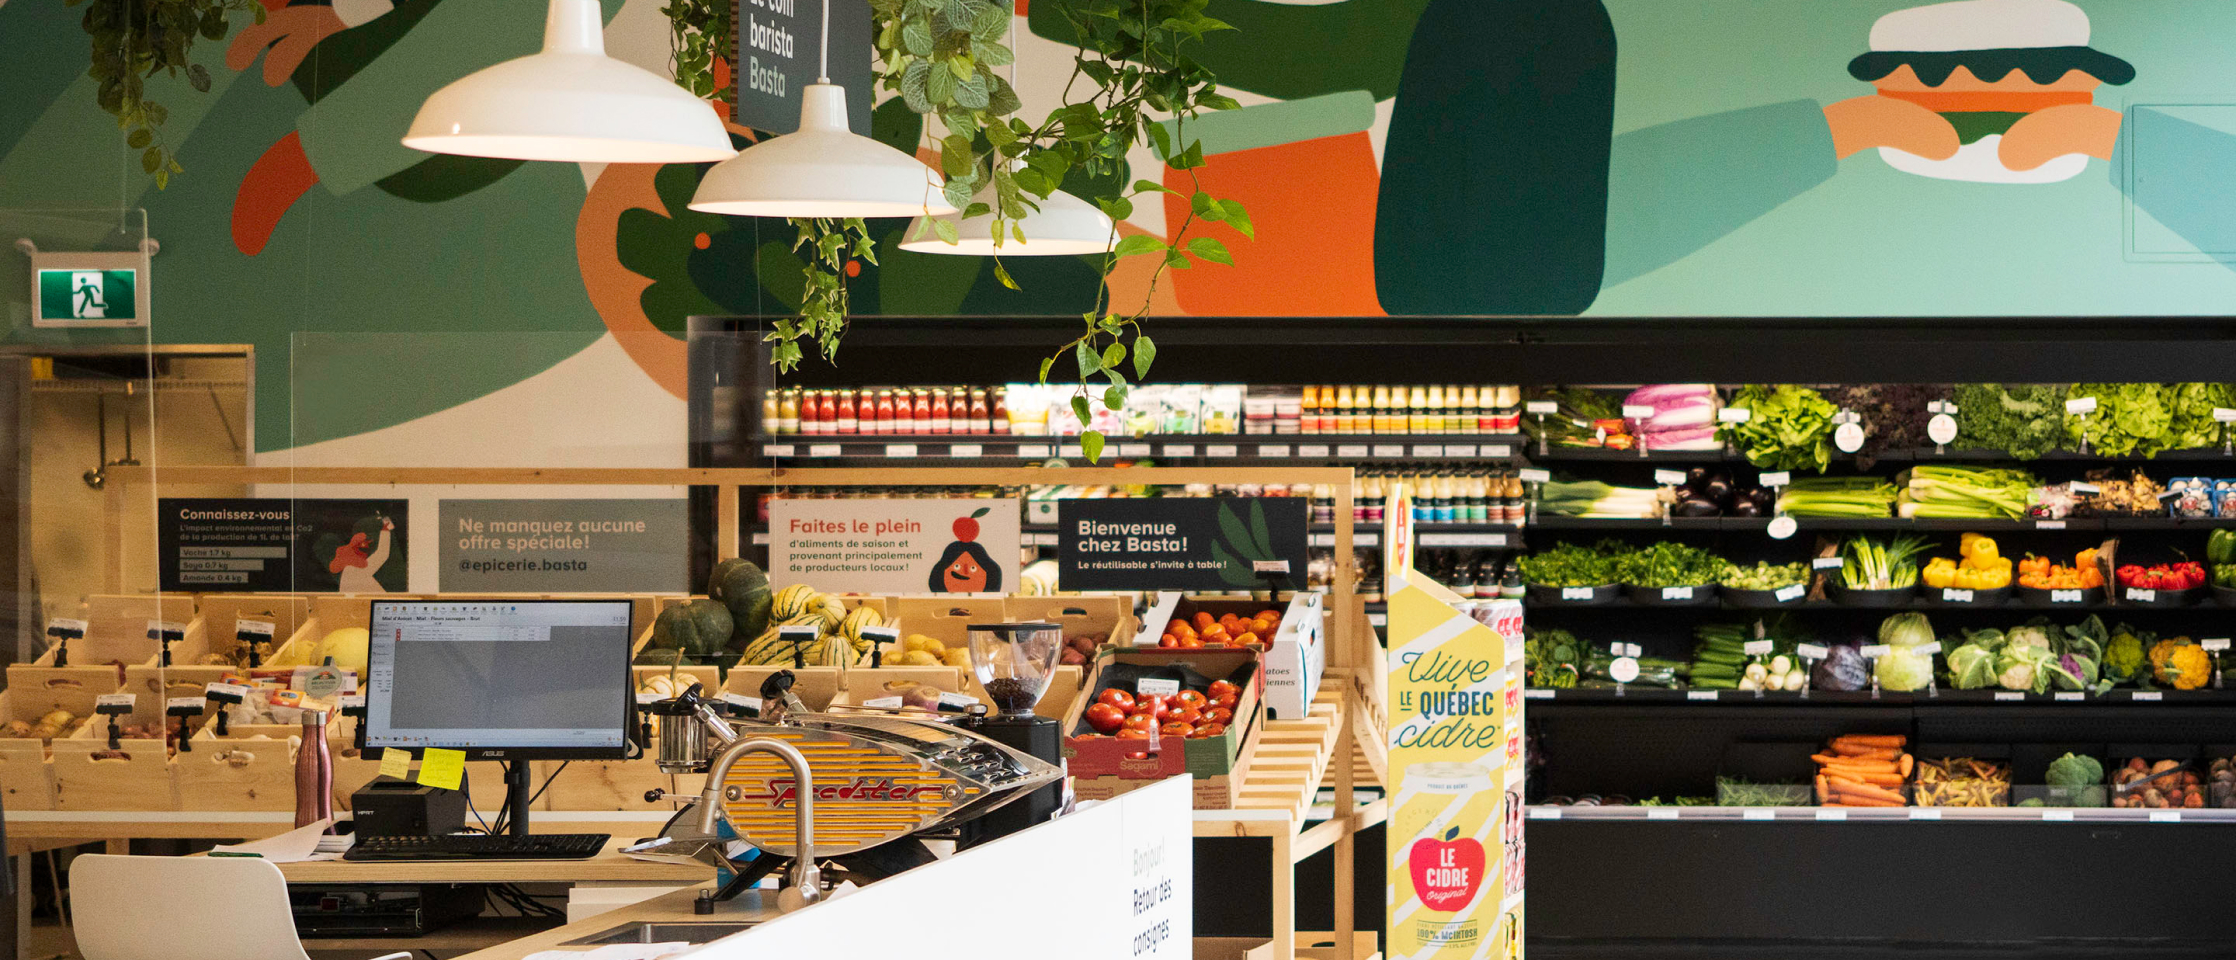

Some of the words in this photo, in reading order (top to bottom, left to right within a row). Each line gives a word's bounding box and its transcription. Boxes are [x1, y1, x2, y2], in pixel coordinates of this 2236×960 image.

[750, 13, 793, 58] barista
[750, 56, 785, 97] Basta
[180, 508, 290, 520] Connaissez-vous
[459, 518, 484, 533] Ne
[490, 521, 573, 536] manquez
[579, 521, 645, 533] aucune
[790, 519, 846, 533] Faites
[853, 518, 869, 533] le
[876, 518, 921, 536] plein
[1078, 520, 1176, 536] Bienvenue
[202, 533, 245, 541] production
[459, 534, 501, 550] offre
[507, 534, 590, 553] spéciale!
[790, 540, 844, 548] d'aliments
[847, 540, 859, 548] de
[1078, 537, 1120, 552] chez
[1127, 537, 1188, 552] Basta!
[221, 549, 231, 558] kg
[790, 552, 842, 562] provenant
[845, 551, 922, 562] principalement
[219, 562, 228, 570] kg
[460, 559, 587, 573] @epicerie.basta
[790, 563, 802, 572] de
[805, 563, 867, 574] producteurs
[870, 563, 909, 572] locaux!
[1078, 561, 1089, 569] Le
[1092, 560, 1148, 569] réutilisable
[1150, 560, 1185, 569] s'invite
[1187, 560, 1194, 569] à
[1197, 560, 1227, 569] table!
[1402, 651, 1489, 683] Vive
[1400, 691, 1412, 706] LE
[1420, 683, 1494, 720] QUÉBEC
[1394, 718, 1496, 748] cidre
[1120, 760, 1159, 772] Sagami
[1133, 836, 1165, 877] Bonjour!
[1440, 848, 1455, 867] LE
[1426, 868, 1469, 887] CIDRE
[1133, 886, 1158, 917] Retour
[1159, 875, 1172, 903] des
[1426, 887, 1468, 902] Original
[1133, 918, 1170, 957] consignes
